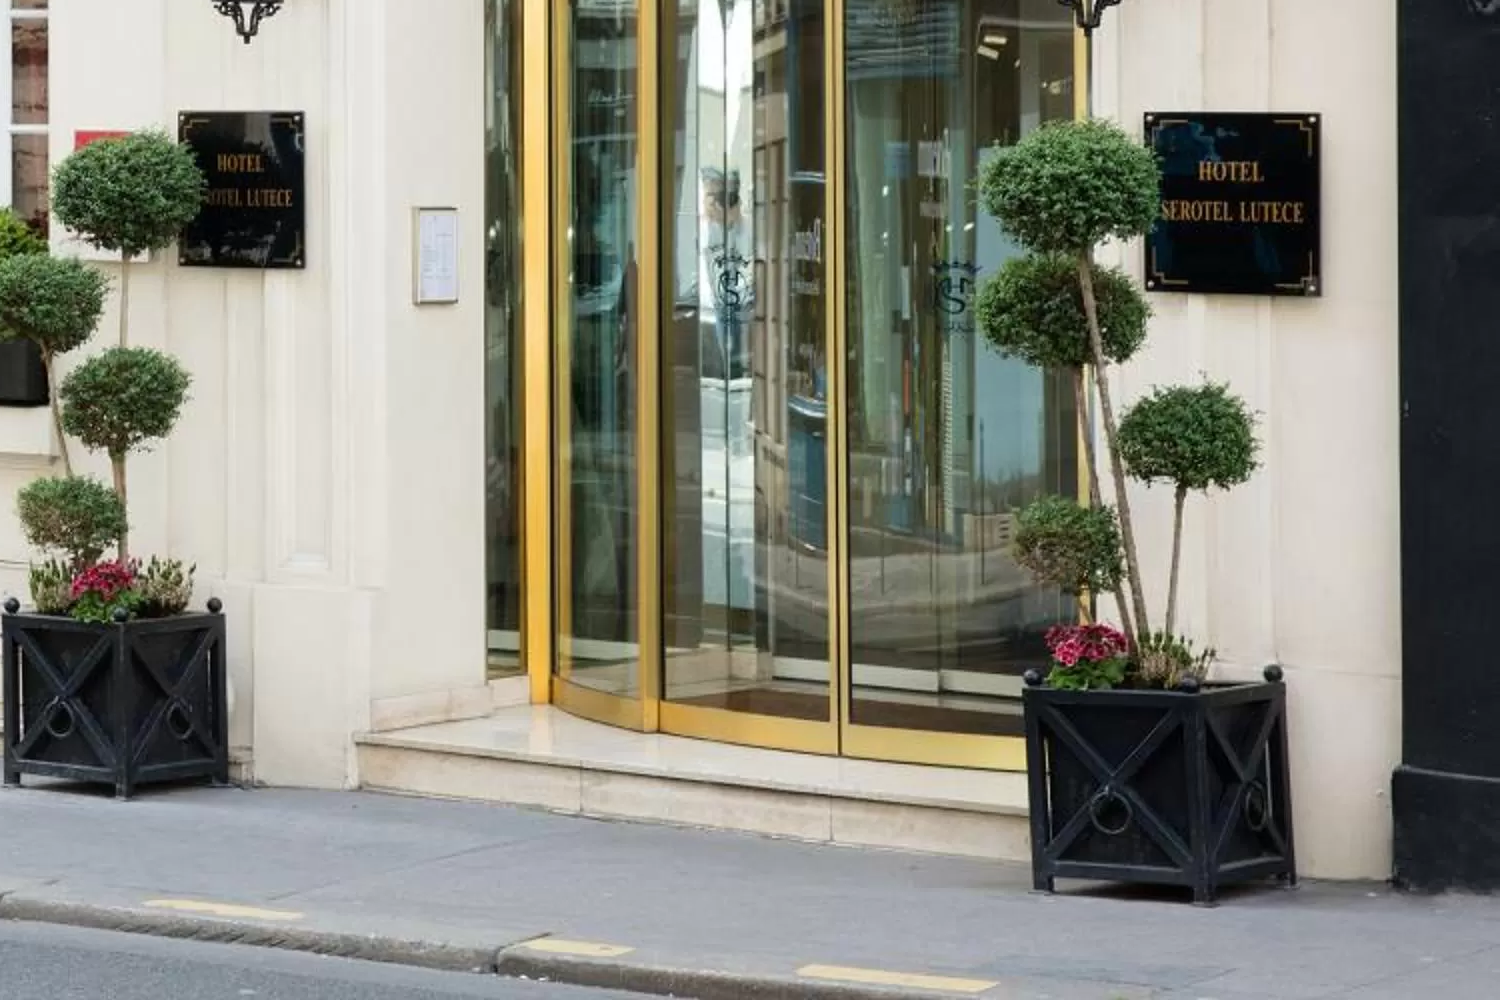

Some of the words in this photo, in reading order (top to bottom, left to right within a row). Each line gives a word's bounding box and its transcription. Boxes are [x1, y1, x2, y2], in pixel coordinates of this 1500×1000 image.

[217, 153, 265, 173] HOTEL
[1199, 161, 1265, 182] HOTEL
[247, 187, 293, 208] LUTECE
[1161, 200, 1234, 222] SEROTEL
[1239, 201, 1305, 224] LUTECE
